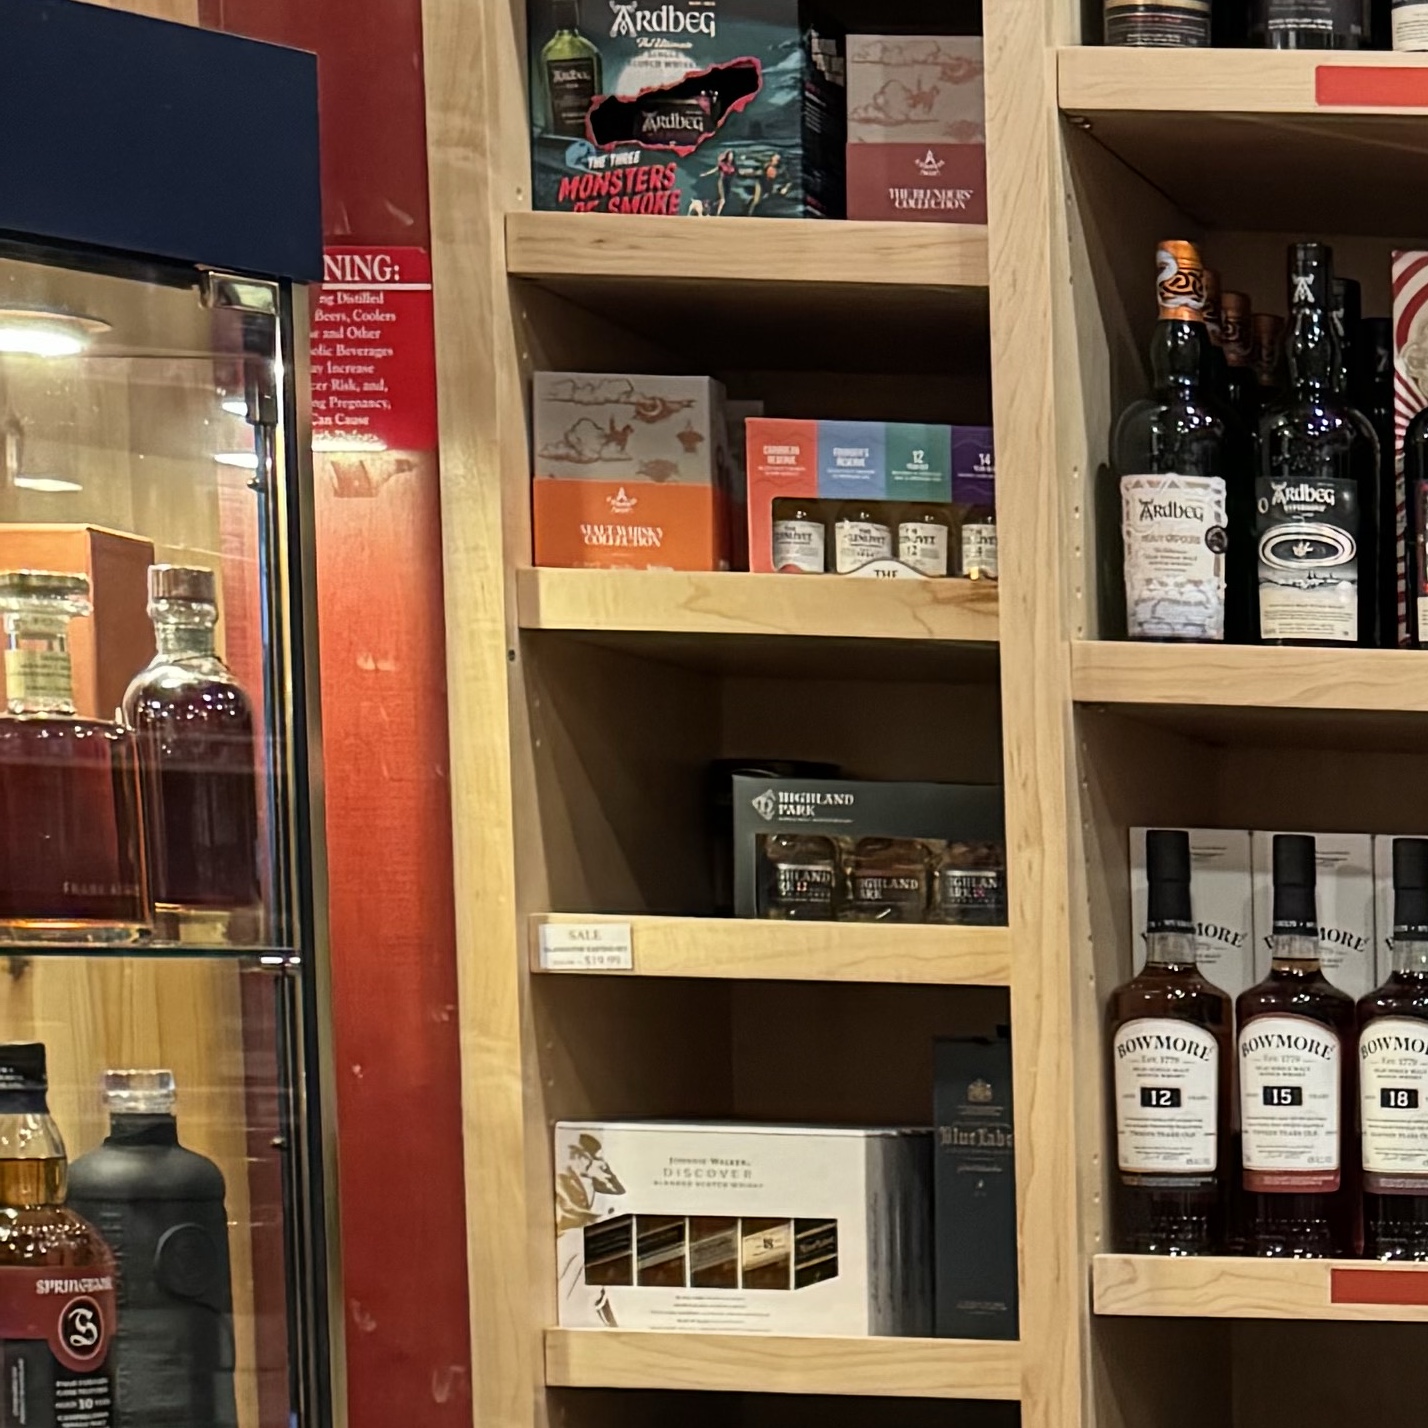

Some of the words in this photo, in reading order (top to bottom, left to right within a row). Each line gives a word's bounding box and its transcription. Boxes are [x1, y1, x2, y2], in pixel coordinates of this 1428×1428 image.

[588, 156, 608, 169] THE
[558, 162, 678, 202] MONSTERS
[314, 309, 348, 322] Beers,
[353, 309, 396, 322] Coolers
[347, 327, 381, 339] Other
[327, 362, 375, 374] Increase
[335, 414, 369, 426] Cause
[778, 792, 854, 805] HIGHLAND
[778, 804, 815, 816] PARK
[568, 930, 601, 940] SALE
[1116, 1033, 1216, 1063] BOWMORE
[1241, 1033, 1336, 1062] BOWMORE
[1150, 1089, 1172, 1106] 12
[1272, 1088, 1293, 1105] 15
[1389, 1091, 1409, 1107] 18
[662, 1166, 753, 1180] DISCOVER
[78, 1397, 93, 1410] 10
